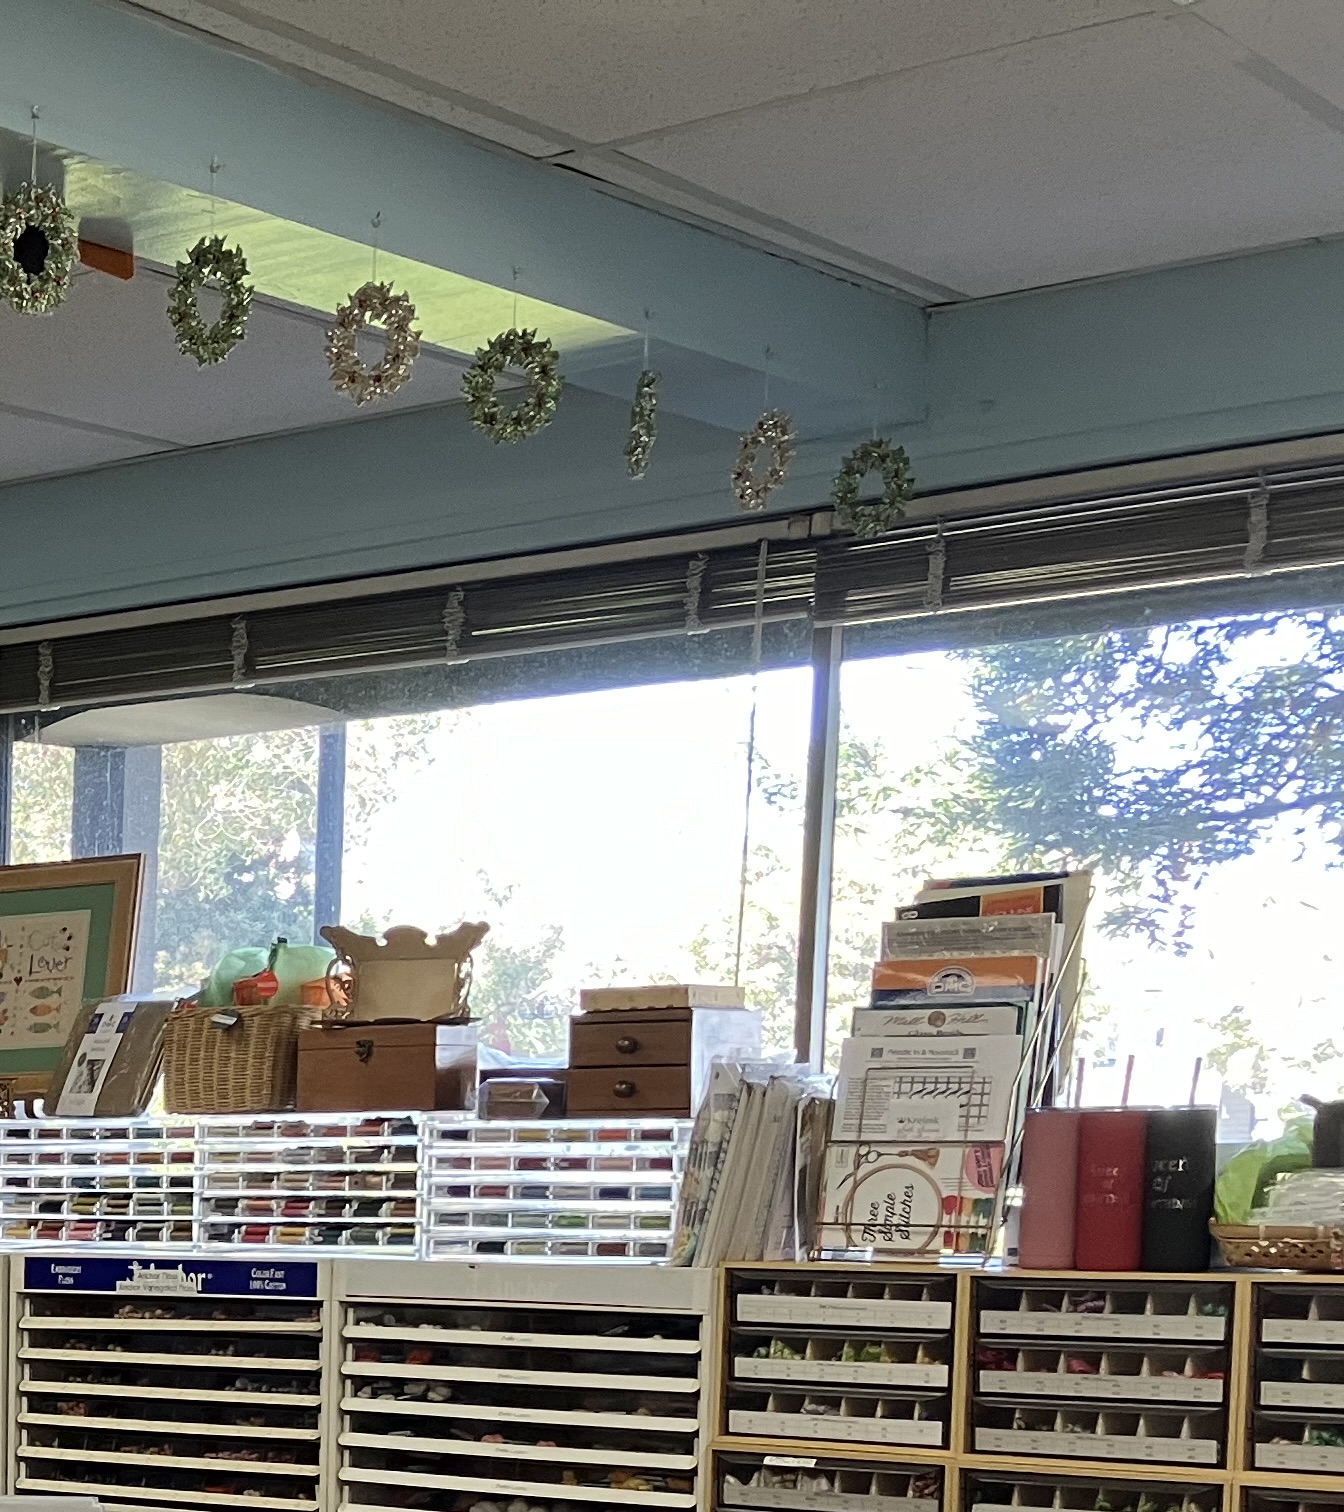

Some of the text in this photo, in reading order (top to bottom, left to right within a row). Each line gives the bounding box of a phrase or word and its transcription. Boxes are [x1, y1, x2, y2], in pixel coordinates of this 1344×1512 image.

[29, 954, 72, 976] Lover
[933, 981, 974, 994] DMC
[862, 1201, 880, 1242] Three
[883, 1192, 896, 1242] Simple
[894, 1184, 915, 1240] Stitches
